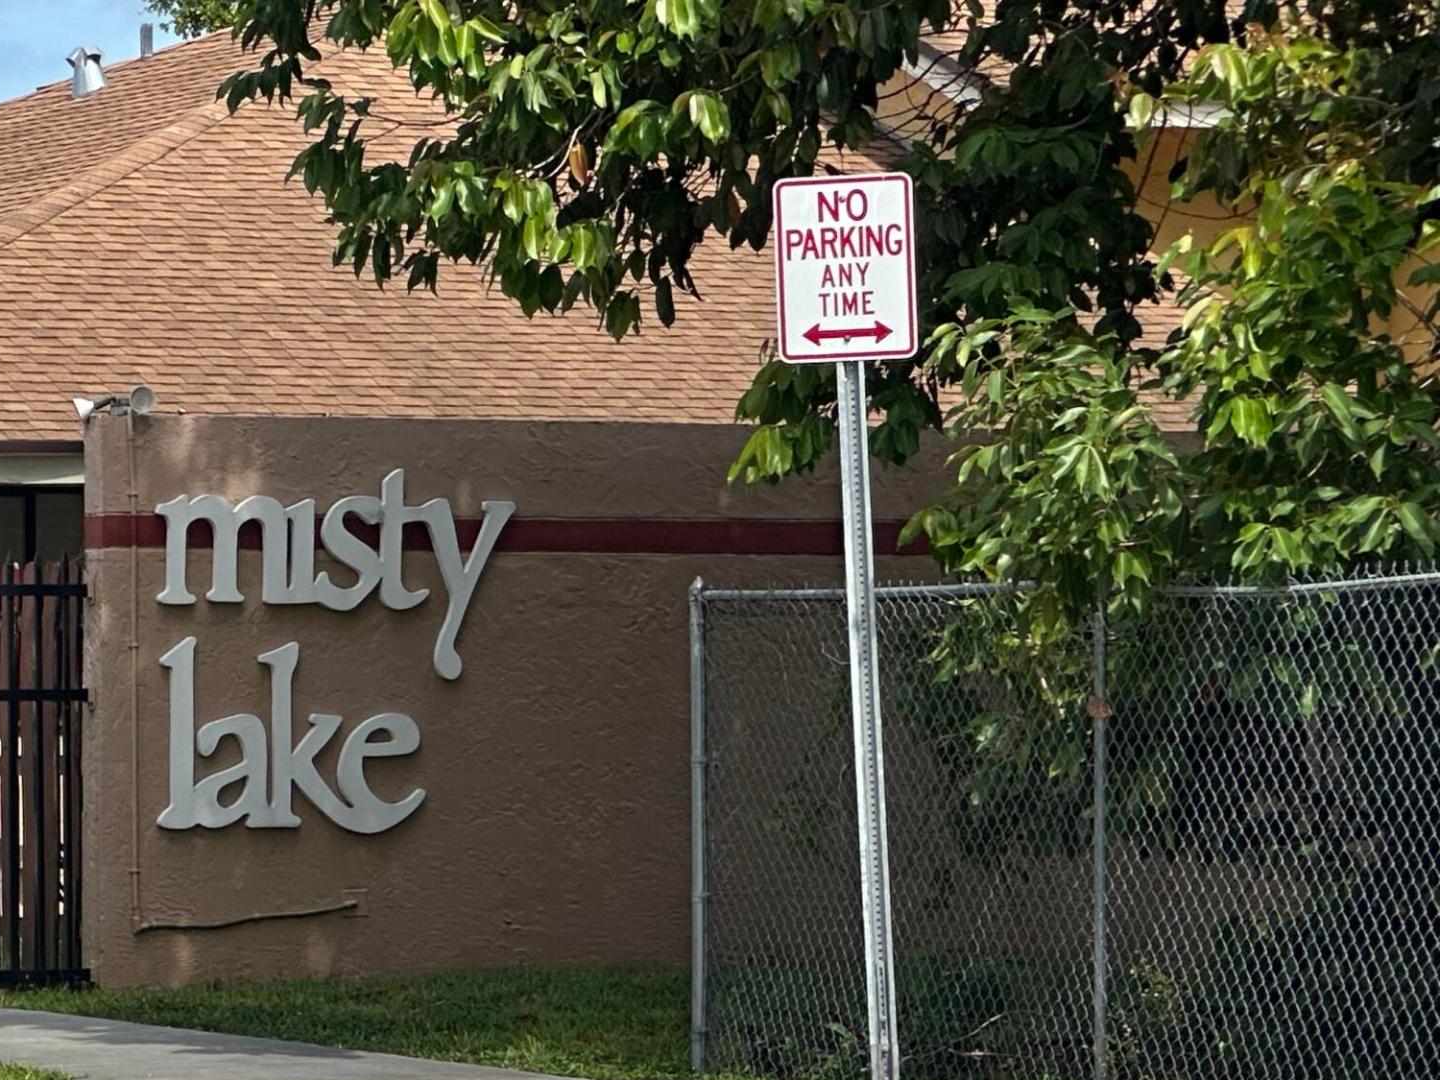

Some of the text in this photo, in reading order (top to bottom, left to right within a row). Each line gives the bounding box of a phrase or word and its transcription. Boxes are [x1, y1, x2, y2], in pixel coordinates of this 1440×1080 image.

[817, 189, 868, 222] NO
[786, 223, 903, 261] PARKING
[821, 262, 870, 288] ANY
[818, 291, 875, 317] TIME
[155, 468, 518, 681] misty
[156, 636, 427, 835] lake
